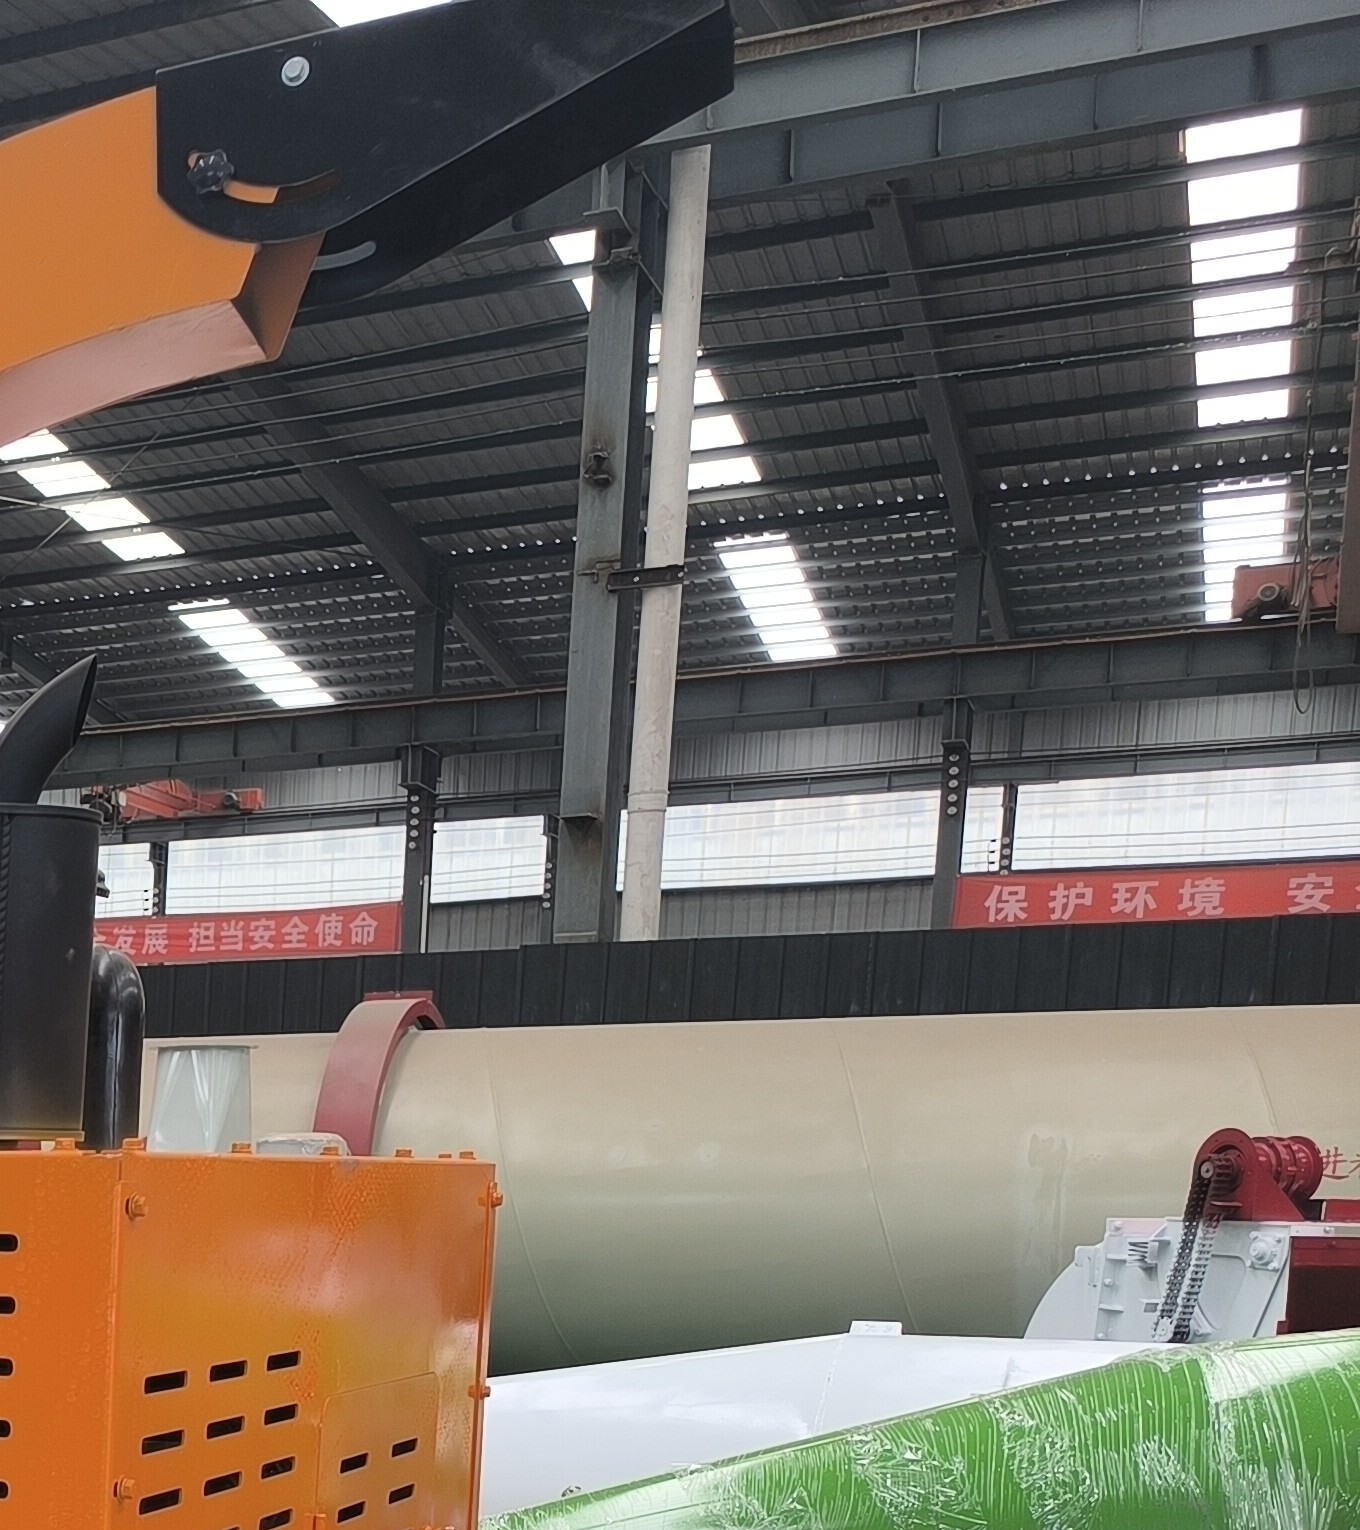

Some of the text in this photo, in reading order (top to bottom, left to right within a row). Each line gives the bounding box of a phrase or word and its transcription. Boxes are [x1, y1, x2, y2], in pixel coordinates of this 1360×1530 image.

[983, 871, 1360, 923] 保护环境 安
[188, 911, 379, 954] 担当安全使命
